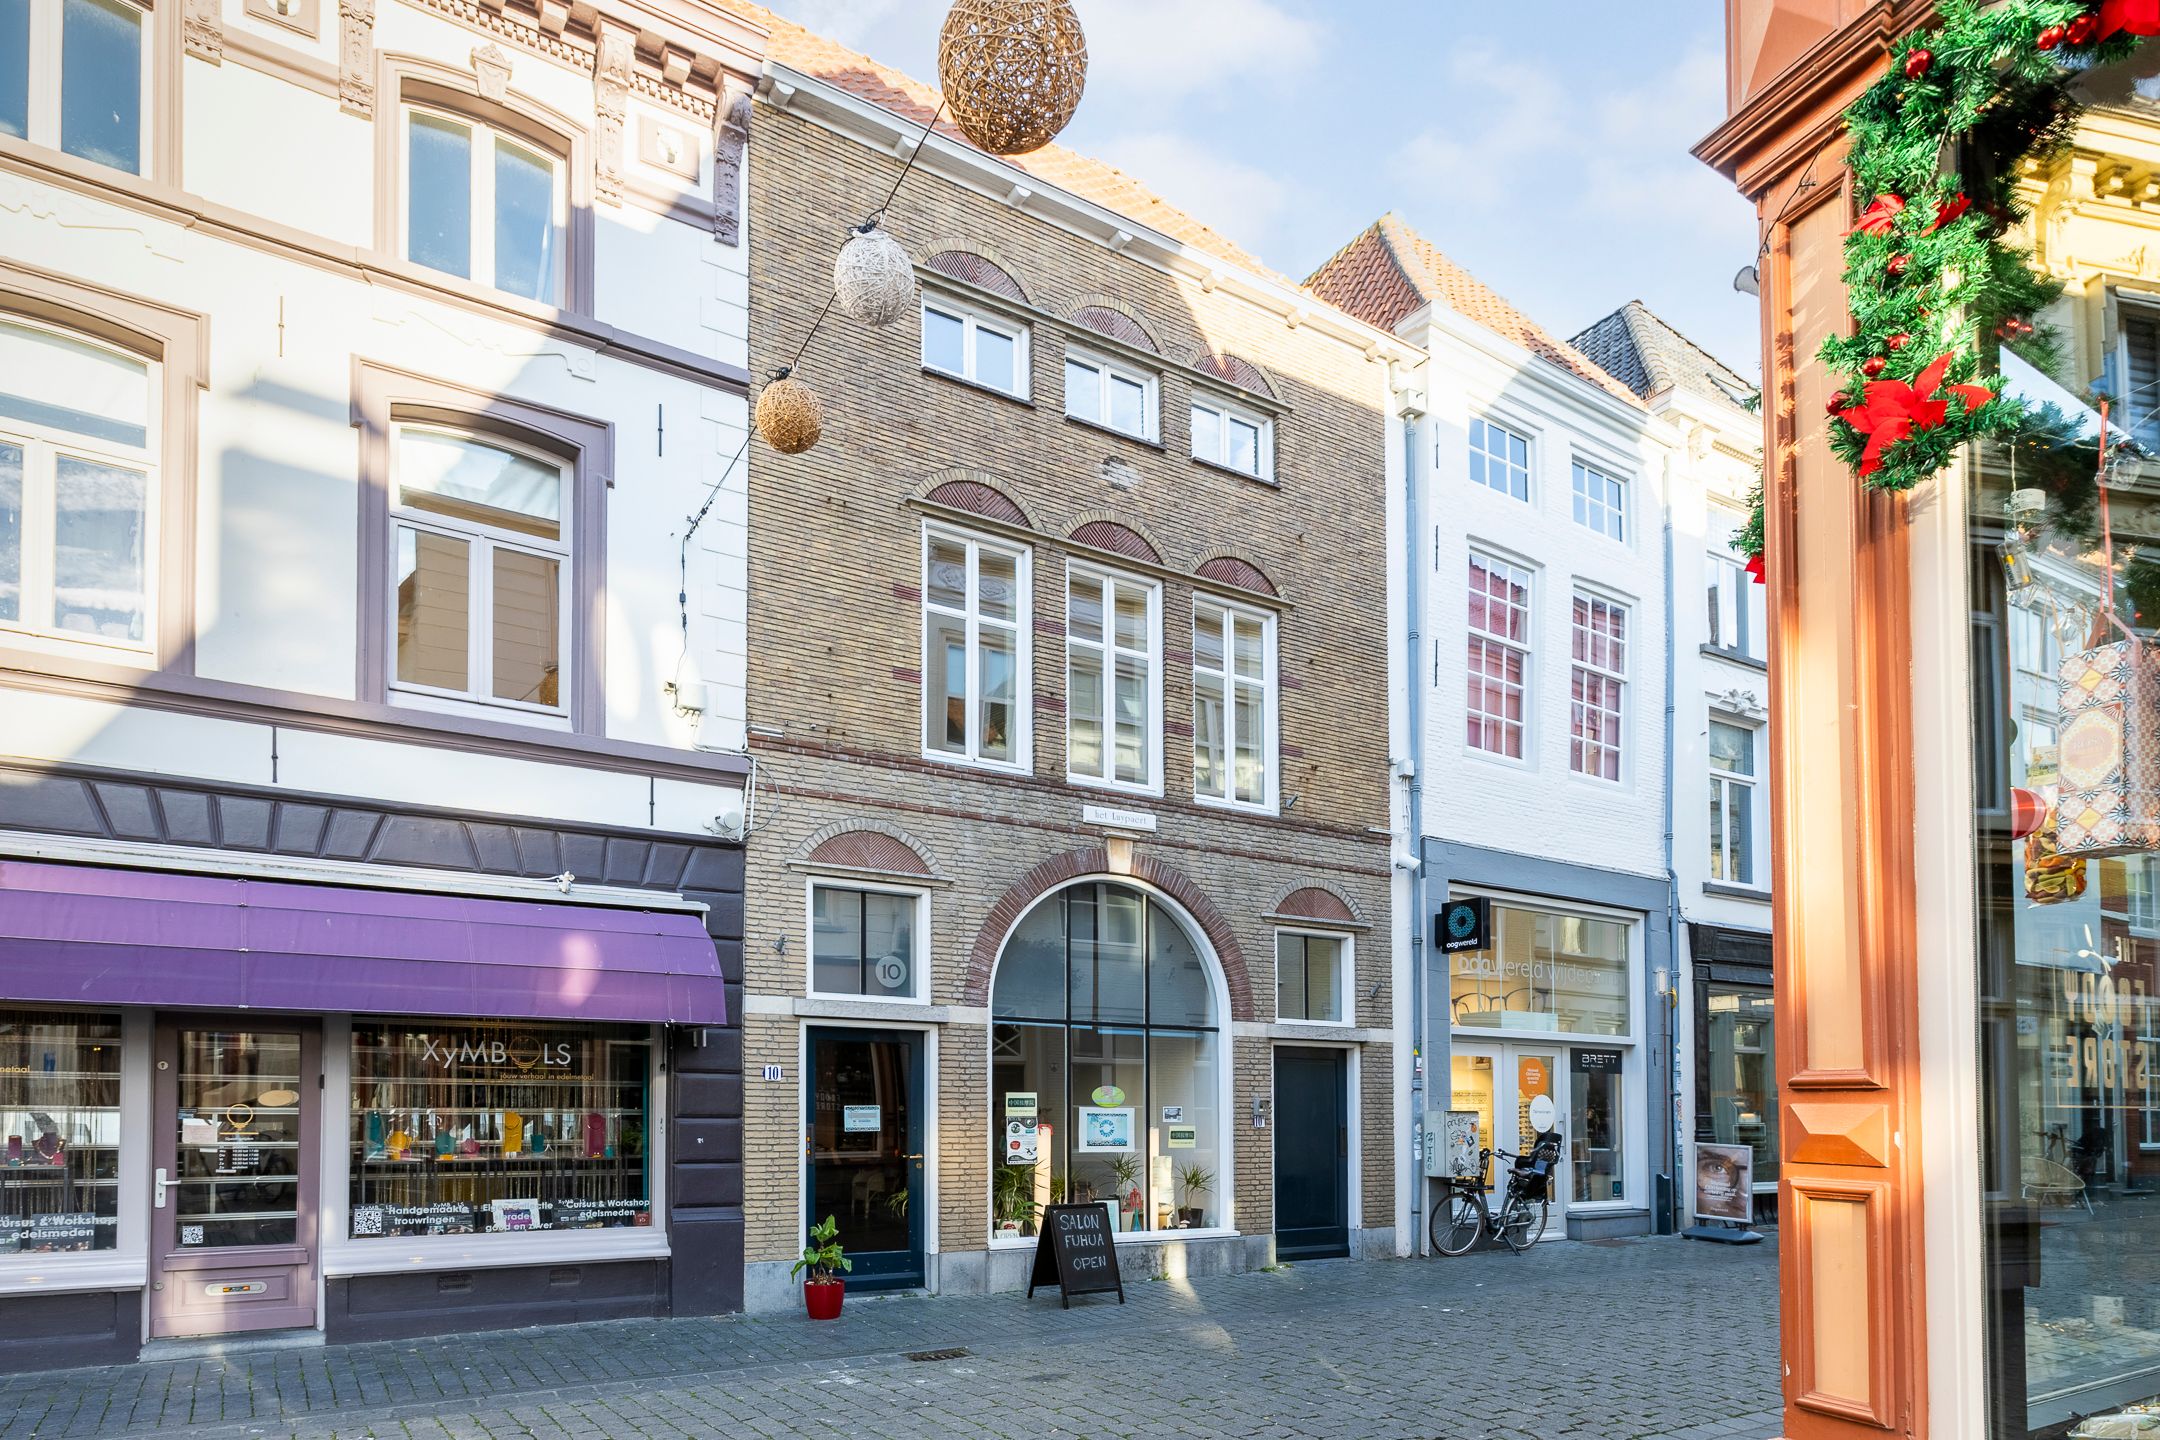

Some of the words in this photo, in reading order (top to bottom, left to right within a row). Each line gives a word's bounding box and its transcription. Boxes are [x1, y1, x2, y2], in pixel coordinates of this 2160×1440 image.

[1446, 937, 1478, 949] oogwereld
[881, 963, 902, 980] 10
[1457, 954, 1544, 979] oogwereld
[1581, 1053, 1617, 1064] BRETT
[520, 1072, 546, 1080] verhaal
[548, 1072, 555, 1080] in
[556, 1072, 595, 1081] edelmetaal
[767, 1066, 779, 1081] 10
[598, 1200, 605, 1208] &
[607, 1198, 650, 1207] Workshop
[388, 1206, 470, 1216] Handgemaakte
[580, 1209, 636, 1218] edelsmeden
[394, 1216, 456, 1226] trouwringen
[1059, 1214, 1100, 1231] SALON
[11, 1228, 95, 1240] edelsmeden
[1064, 1233, 1105, 1249] FUHUA
[1073, 1255, 1107, 1271] OPEN
